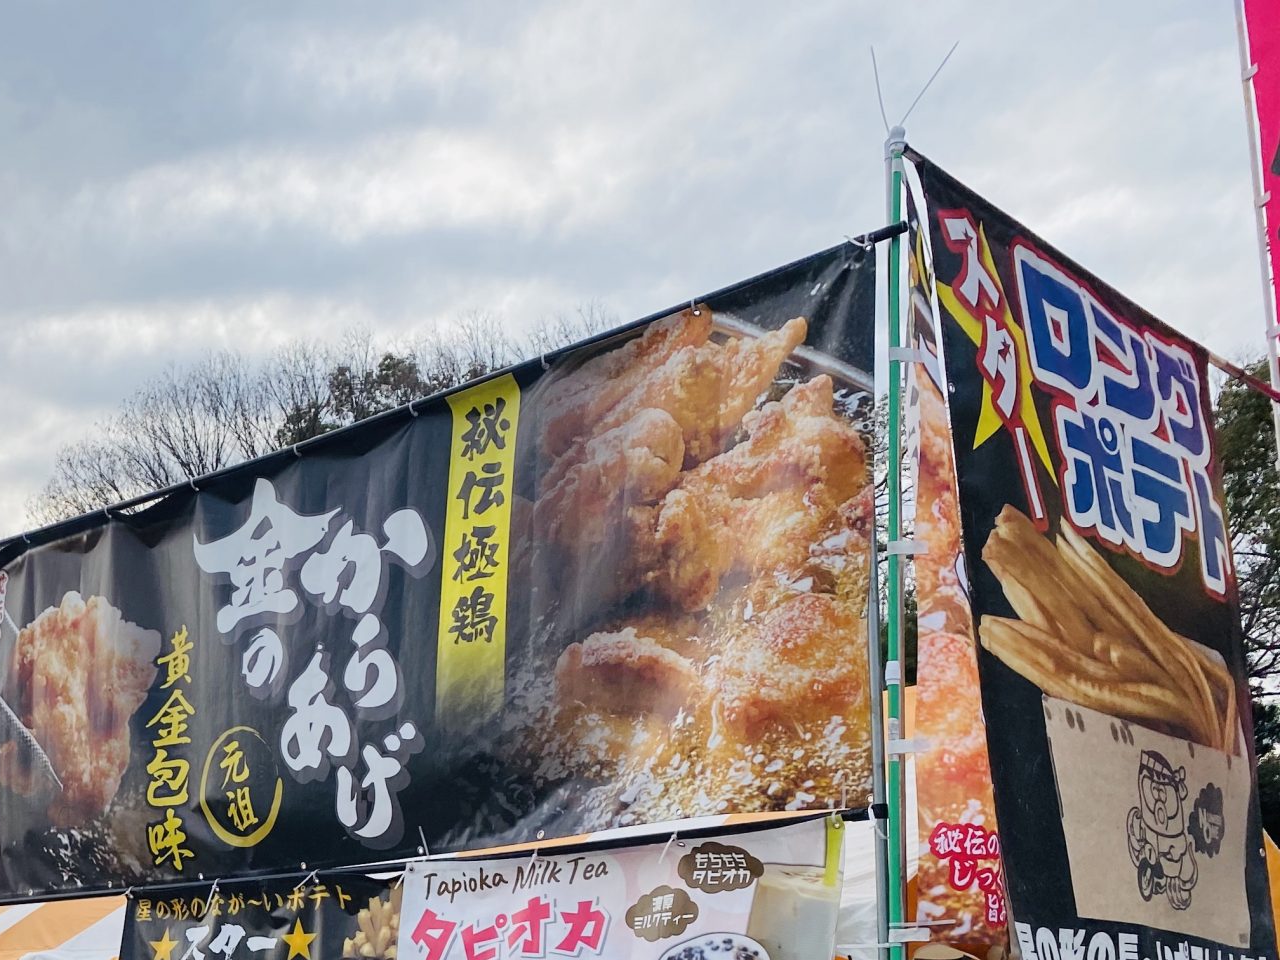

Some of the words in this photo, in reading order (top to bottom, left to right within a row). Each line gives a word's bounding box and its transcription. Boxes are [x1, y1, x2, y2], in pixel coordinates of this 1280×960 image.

[943, 216, 1044, 520] スター
[1018, 254, 1206, 460] ロング
[193, 477, 342, 688] 金の
[448, 397, 510, 644] 秘伝極鶏
[1060, 408, 1227, 586] ポテト
[146, 624, 196, 871] 黄金包味
[281, 507, 431, 838] からあげ
[219, 741, 259, 831] 元祖
[694, 853, 747, 869] もちもち
[933, 827, 1000, 855] 秘伝の
[423, 871, 509, 902] Tapioka
[512, 859, 562, 894] Milk
[566, 856, 609, 885] Tea
[634, 912, 694, 930] ミルクティー
[693, 869, 751, 885] タピオカ
